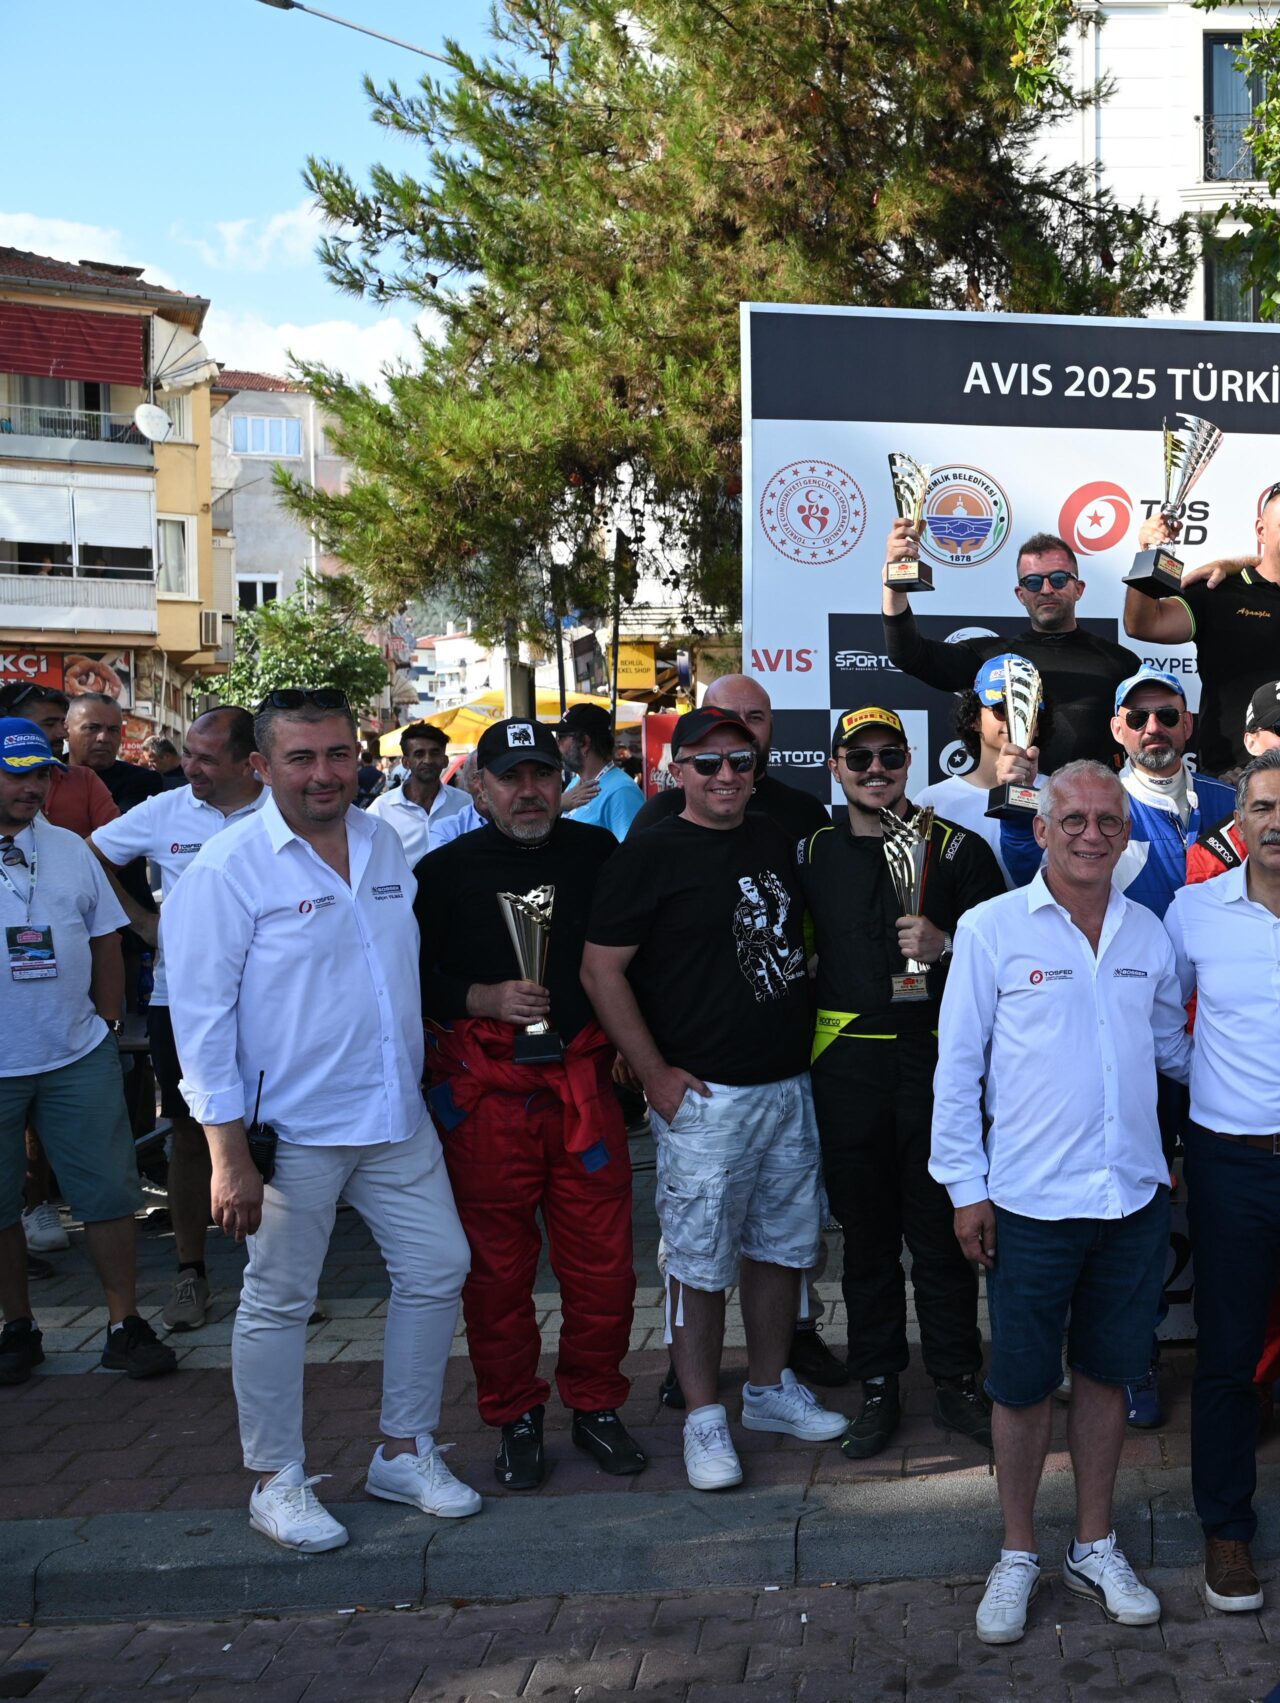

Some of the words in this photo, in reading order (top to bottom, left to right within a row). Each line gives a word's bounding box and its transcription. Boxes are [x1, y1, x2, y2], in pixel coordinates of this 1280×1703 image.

[963, 361, 1053, 396] AVIS
[1064, 365, 1157, 399] 2025
[952, 472, 997, 497] BELEDİYESİ
[949, 554, 972, 562] 1878
[751, 649, 813, 672] AVIS
[945, 832, 966, 861] sparco
[1206, 837, 1233, 863] sparco
